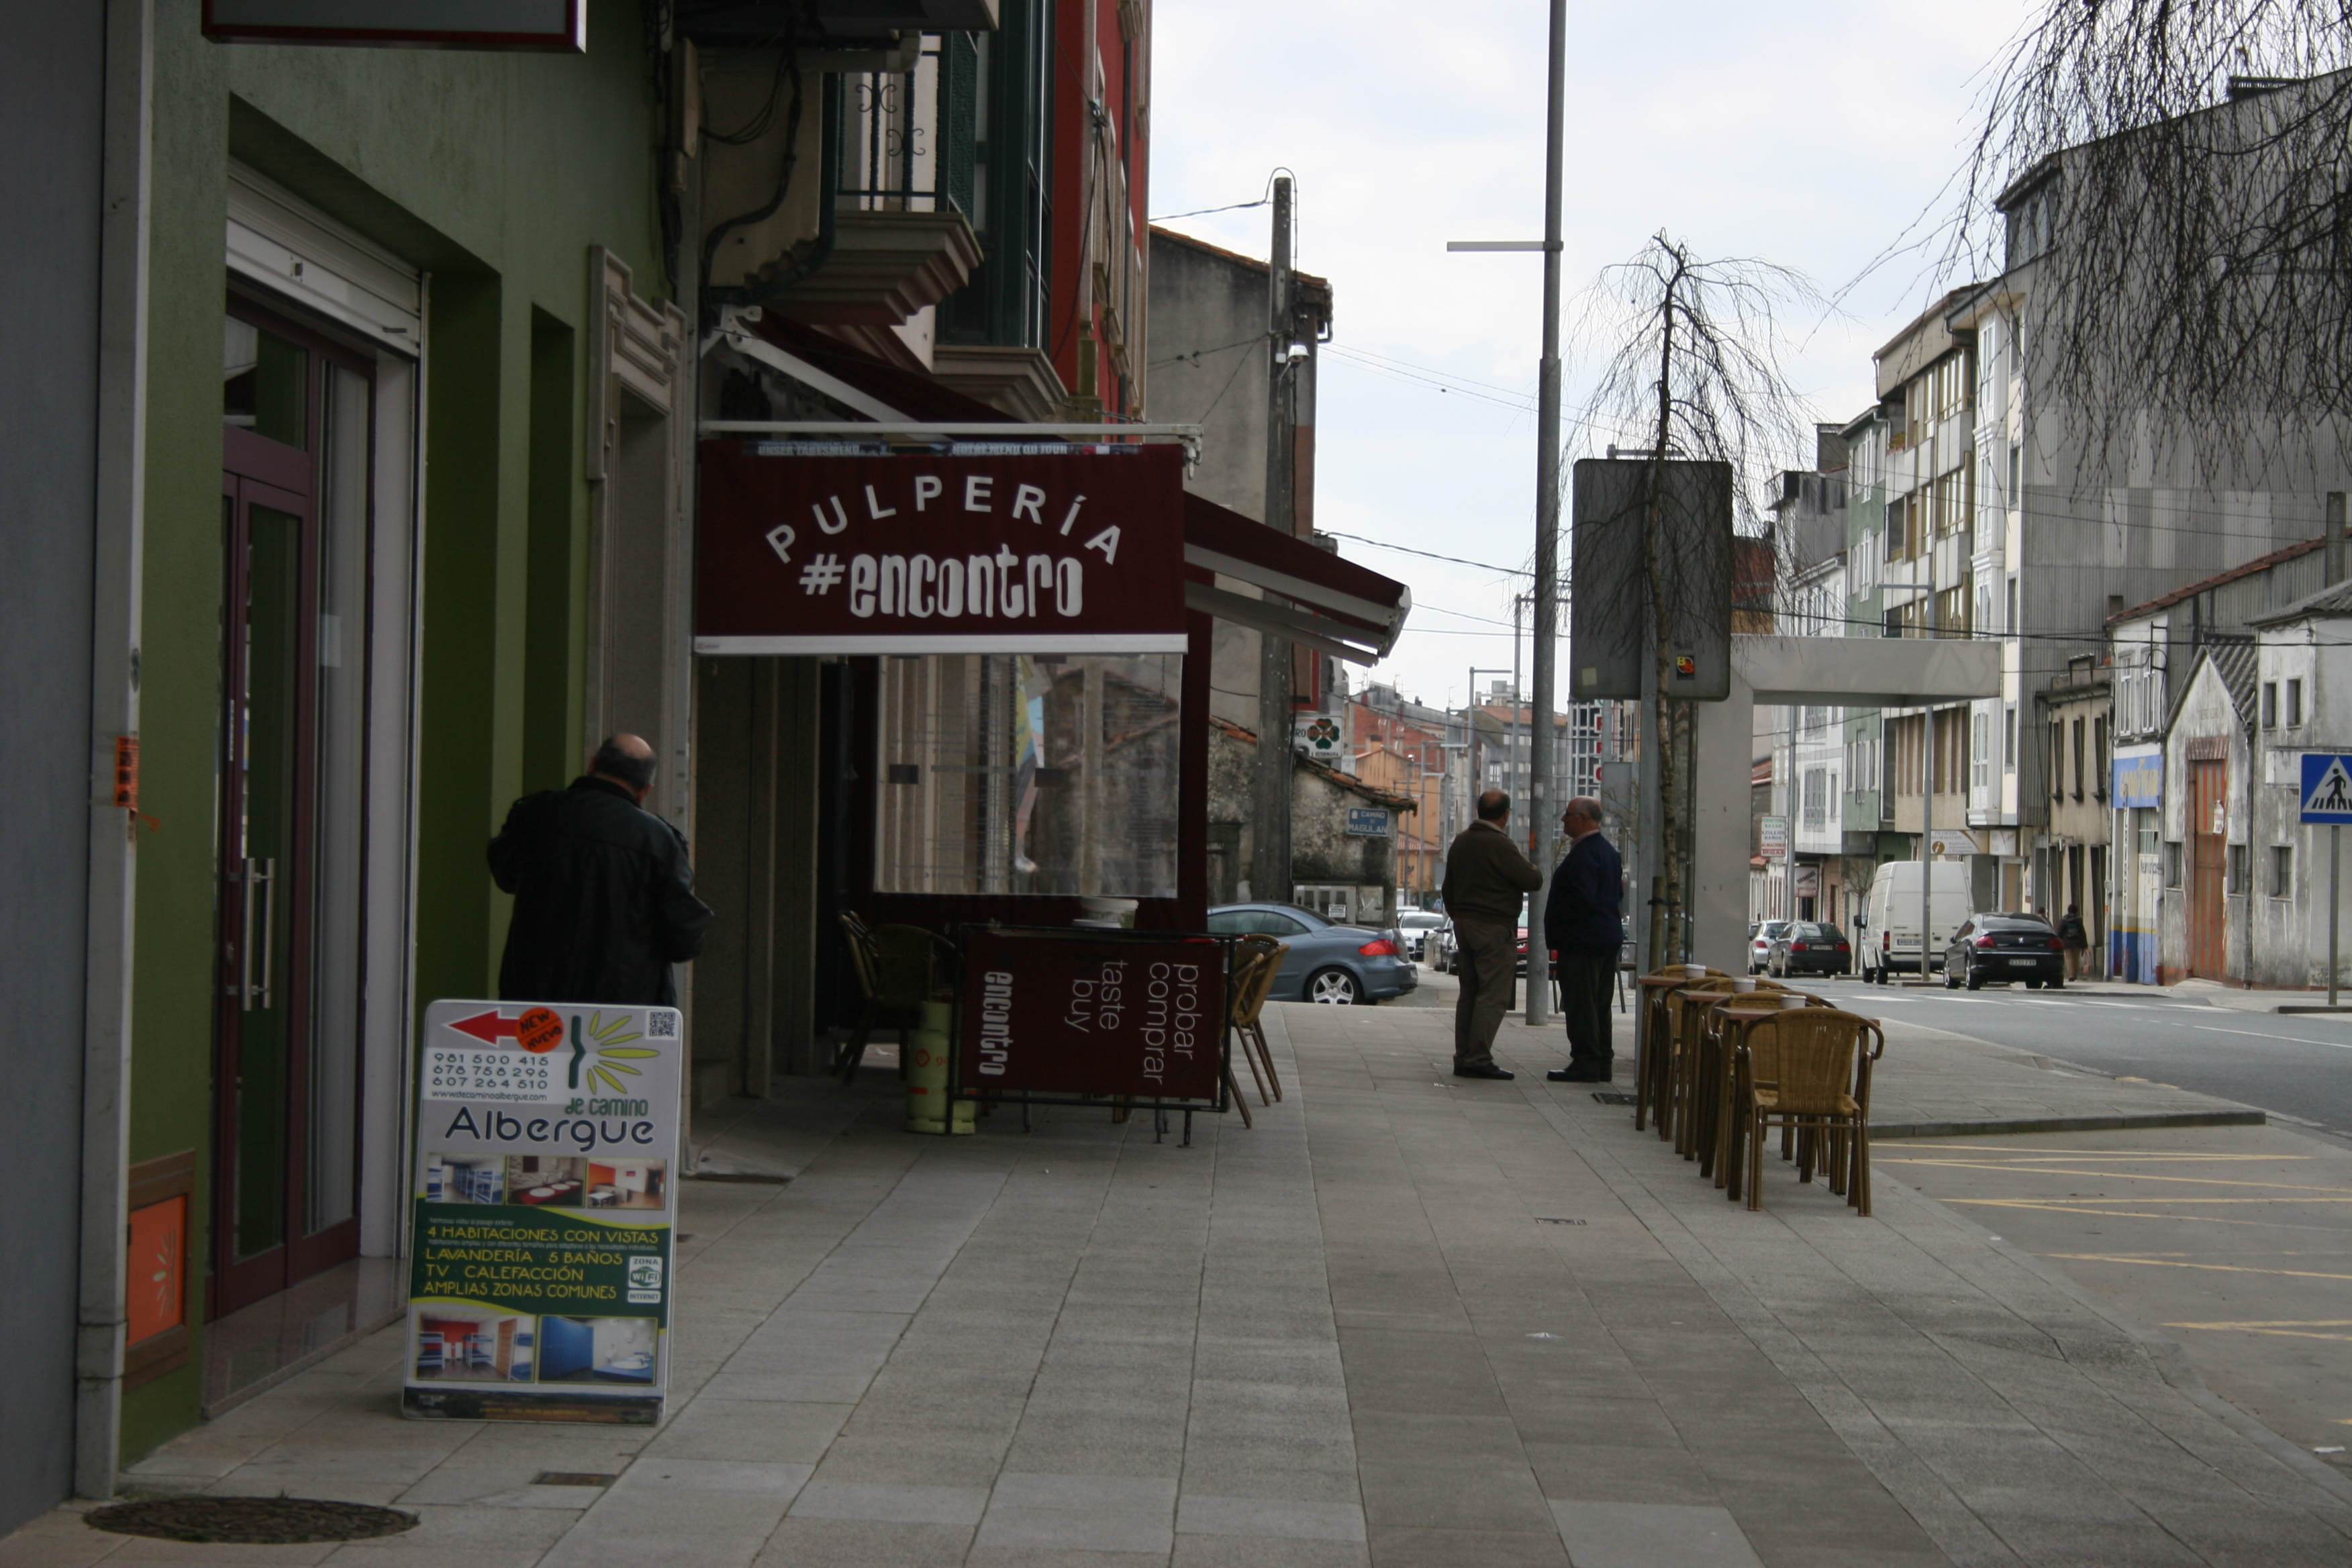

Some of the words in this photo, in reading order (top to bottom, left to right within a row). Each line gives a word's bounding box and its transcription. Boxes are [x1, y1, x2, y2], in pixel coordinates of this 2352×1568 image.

[1040, 445, 1068, 455] JOUR
[765, 475, 1121, 565] PULPERÍA
[1099, 960, 1128, 1030] taste
[1065, 979, 1099, 1033] buy
[1173, 964, 1203, 1061] probar
[520, 1010, 549, 1034] NEW
[979, 971, 1014, 1076] encontro
[1140, 962, 1169, 1085] comprar
[527, 1025, 562, 1050] NUEVO
[434, 1052, 464, 1063] 981
[473, 1055, 509, 1065] 500
[519, 1057, 548, 1066] 415
[434, 1065, 466, 1075] 678
[473, 1066, 506, 1077] 758
[512, 1067, 548, 1078] 296
[433, 1077, 468, 1087] 607
[475, 1078, 510, 1088] 264
[518, 1079, 548, 1089] 510
[565, 1097, 584, 1116] de
[589, 1099, 648, 1116] camino
[444, 1106, 654, 1153] Albergue
[428, 1226, 436, 1238] 4
[442, 1226, 559, 1241] HABITACIONES
[565, 1230, 601, 1242] CON
[606, 1231, 658, 1244] VISTAS
[426, 1247, 533, 1263] LAVANDERÍA
[549, 1252, 558, 1263] 5
[564, 1250, 623, 1265] BAÑOS
[426, 1263, 450, 1277] TV
[464, 1265, 584, 1281] CALEFACCIÓN
[424, 1281, 489, 1295] AMPLIAS
[492, 1282, 542, 1297] ZONAS
[547, 1284, 617, 1300] COMUNES
